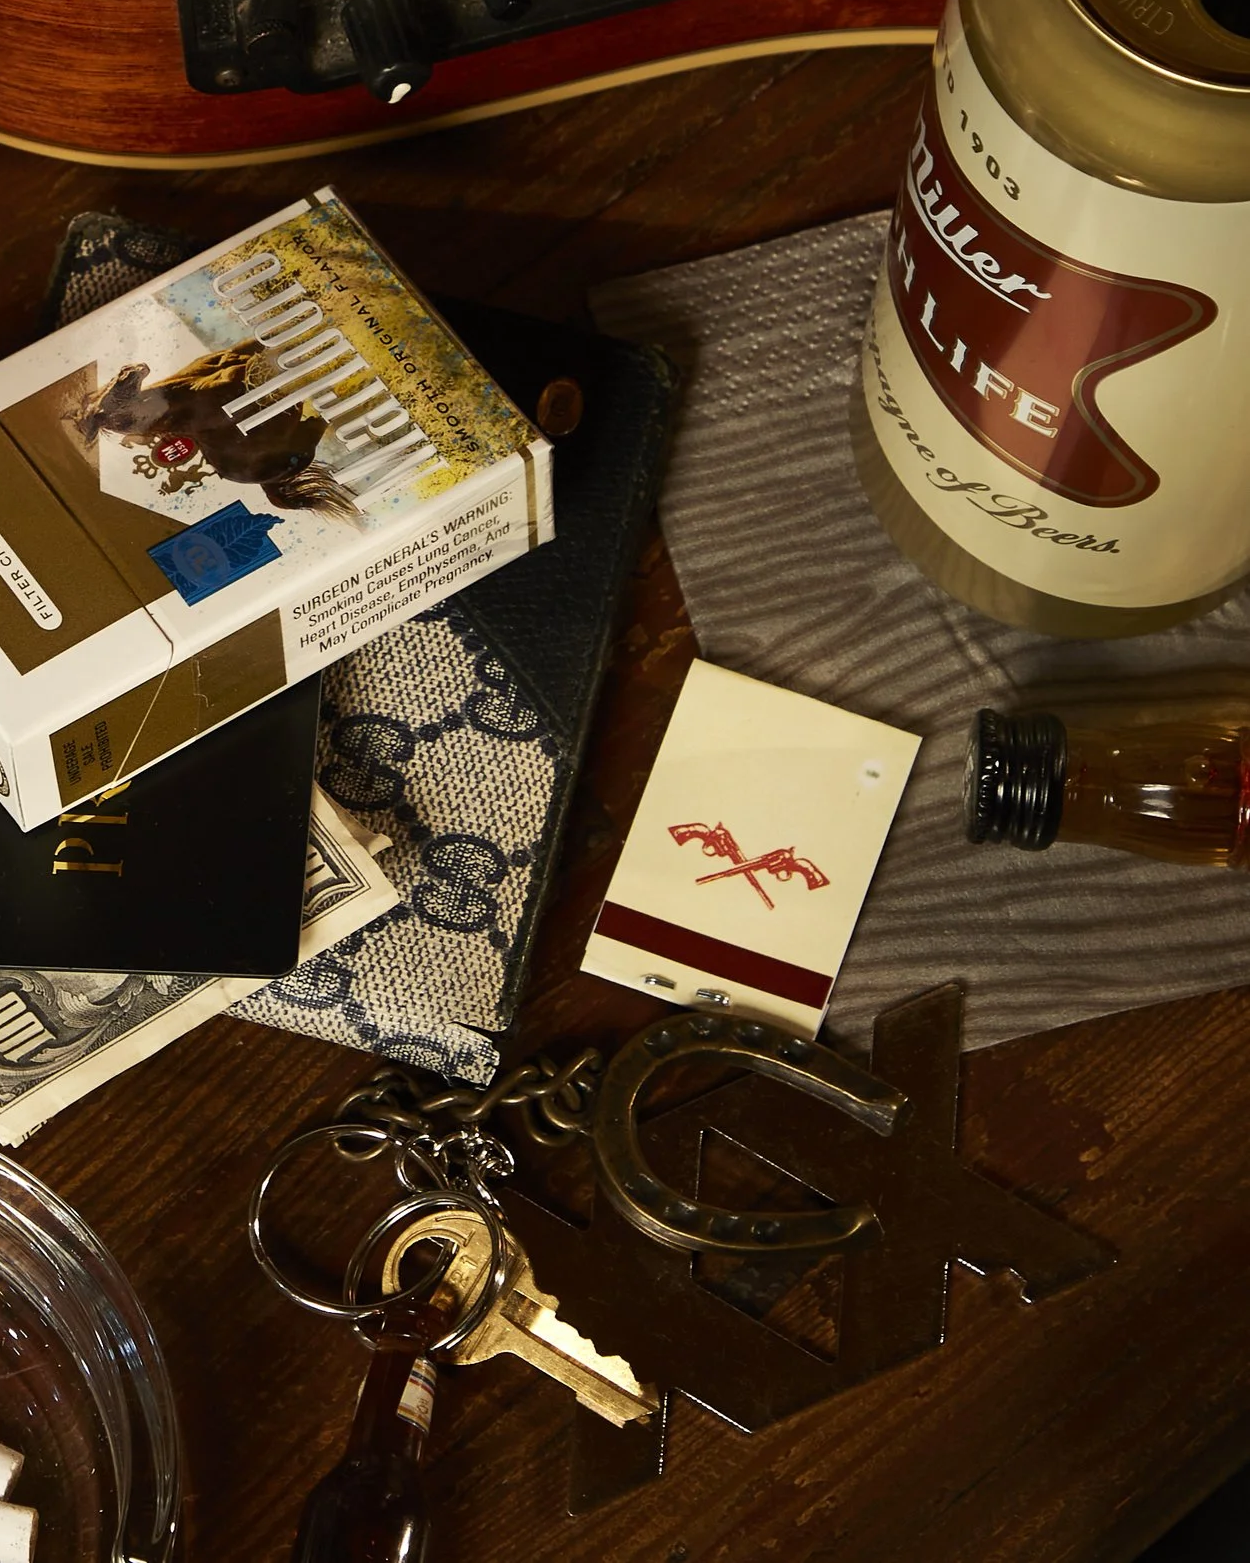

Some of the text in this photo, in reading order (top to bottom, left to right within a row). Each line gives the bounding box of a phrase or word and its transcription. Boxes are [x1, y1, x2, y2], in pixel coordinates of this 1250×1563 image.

[959, 109, 1021, 201] 1903
[907, 106, 1053, 314] Miller
[351, 293, 417, 376] ORIGINAL
[918, 290, 1060, 439] LIFE
[211, 251, 450, 517] Marlboro
[417, 378, 481, 453] SMOOTH
[161, 445, 181, 462] PM
[174, 440, 189, 455] USA
[293, 491, 514, 620] SURGEON GENERAL'S WARNING:
[925, 463, 992, 494] of
[965, 490, 1121, 556] Beers.
[9, 570, 54, 622] FILTER
[300, 522, 511, 649] Heart Disease, Emphysema, And
[308, 515, 501, 628] Smoking Causes Lung Cancer,
[319, 548, 494, 656] May Complicate Pregnancy.
[63, 740, 81, 786] UNDERAGE
[81, 742, 95, 766] SALE
[94, 720, 113, 772] PROHIBITED
